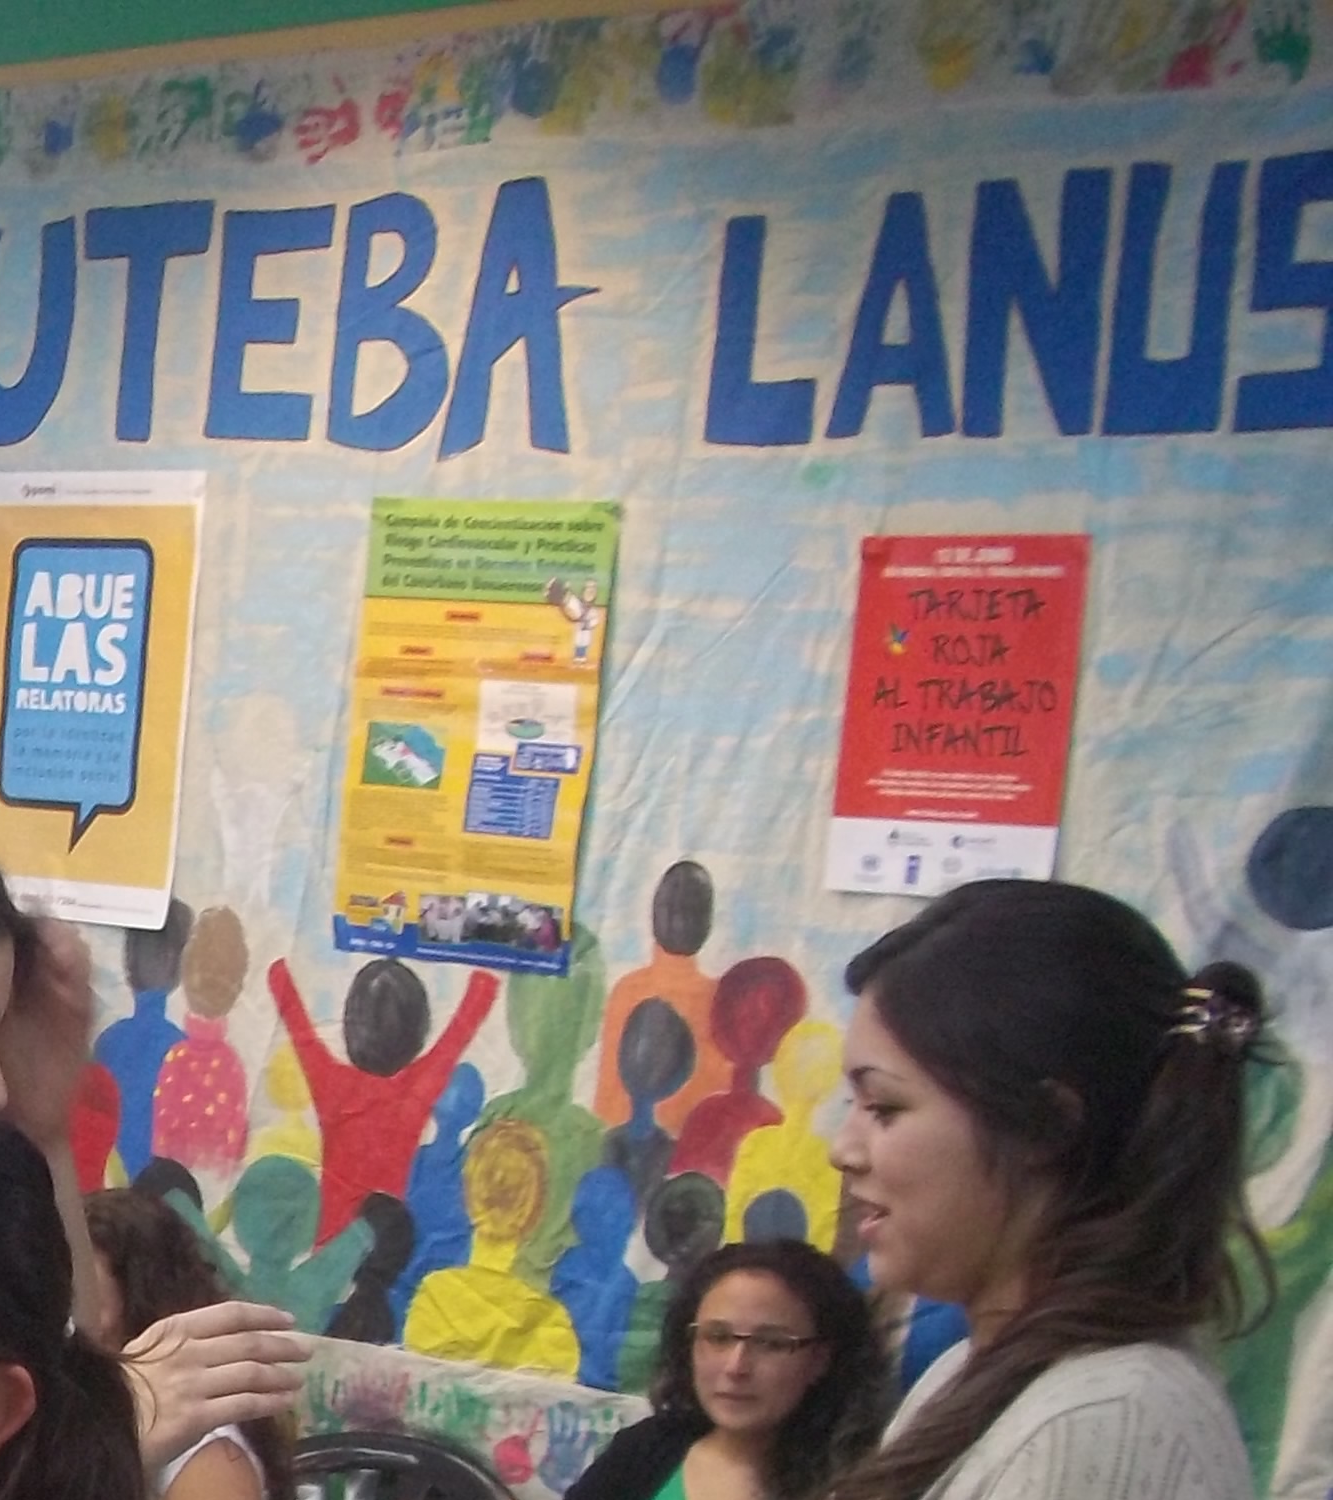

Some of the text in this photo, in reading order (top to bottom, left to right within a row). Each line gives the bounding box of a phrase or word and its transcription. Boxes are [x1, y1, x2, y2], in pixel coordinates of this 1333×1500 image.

[703, 148, 1333, 447] LANUS
[23, 571, 135, 620] ABUE
[908, 588, 1046, 621] TARJETA
[19, 622, 129, 686] LAS
[931, 634, 1011, 667] ROJA
[15, 688, 126, 714] RELATORAS
[873, 676, 1057, 714] AL TRABAJO
[891, 723, 1029, 757] INFANTIL
